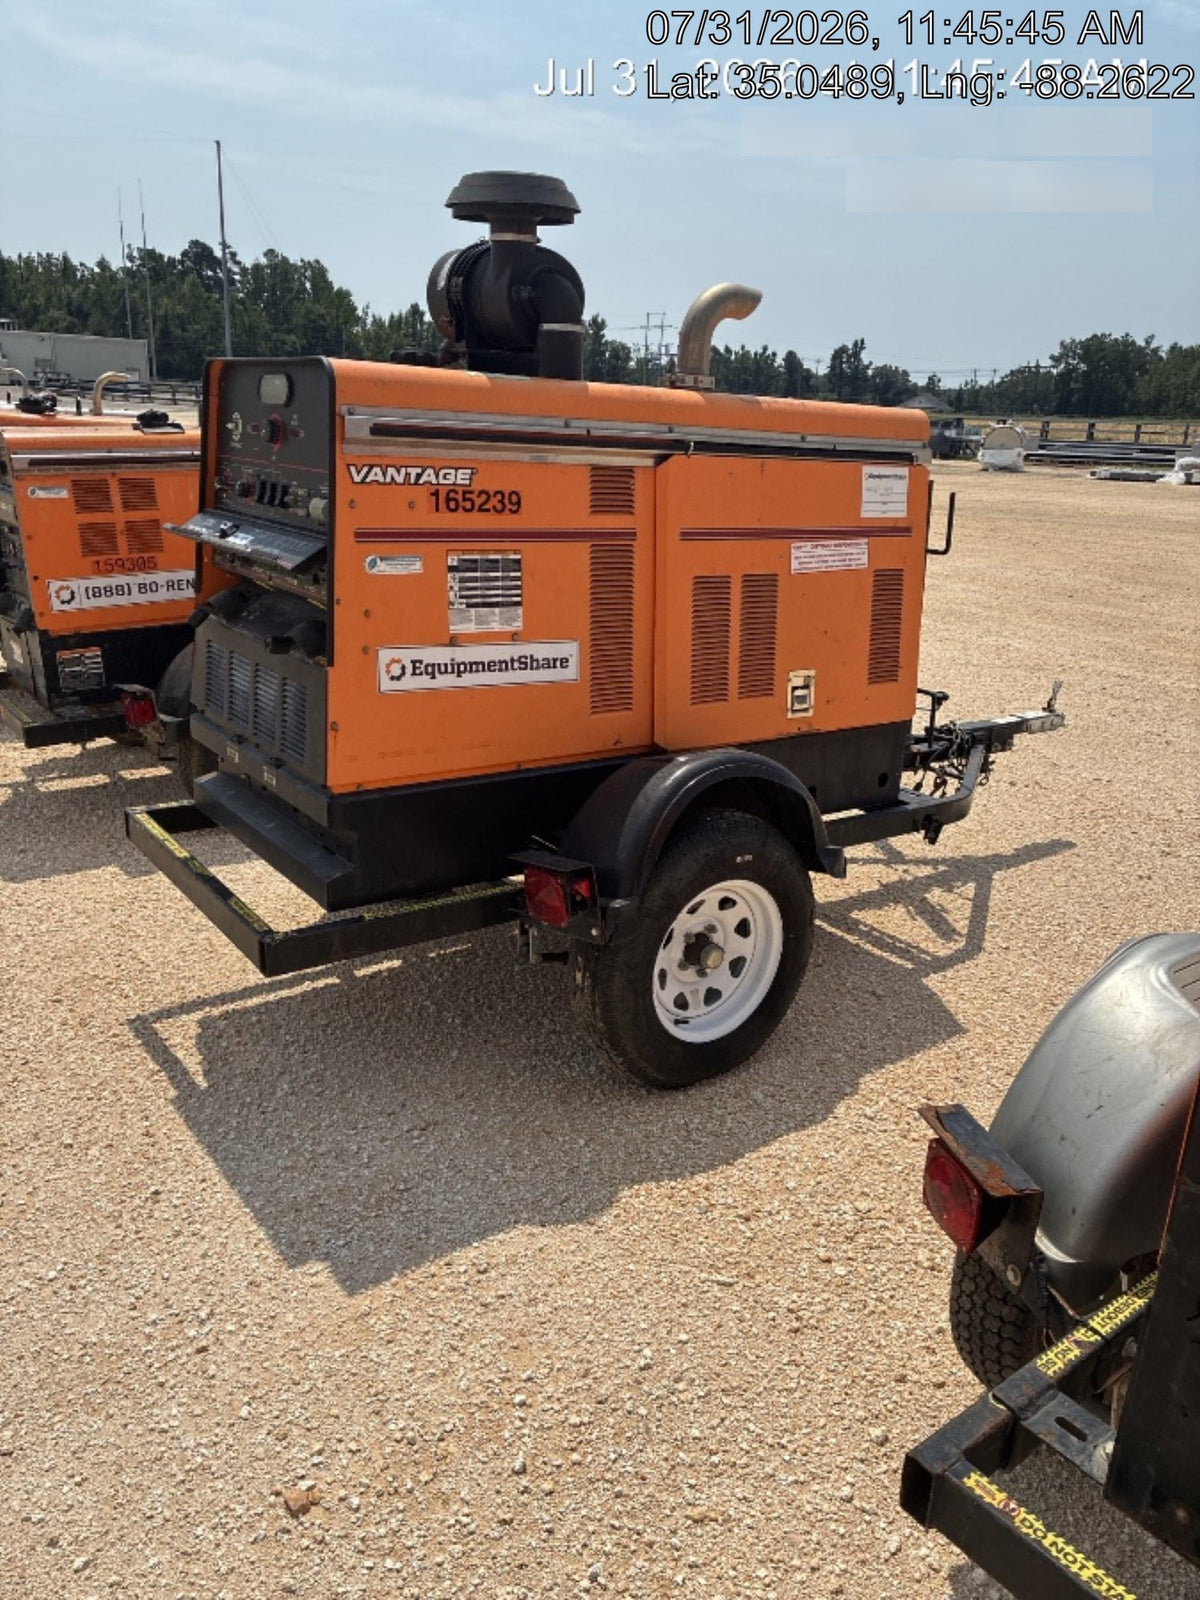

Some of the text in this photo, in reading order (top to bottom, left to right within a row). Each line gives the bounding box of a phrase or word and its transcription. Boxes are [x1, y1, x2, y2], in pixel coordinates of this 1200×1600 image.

[347, 464, 473, 487] VANTAGE
[430, 489, 522, 514] 165239
[93, 556, 158, 573] 159305
[410, 653, 570, 678] EquipmentShare
[1020, 1516, 1048, 1540] DO
[1049, 1540, 1091, 1572] NOT
